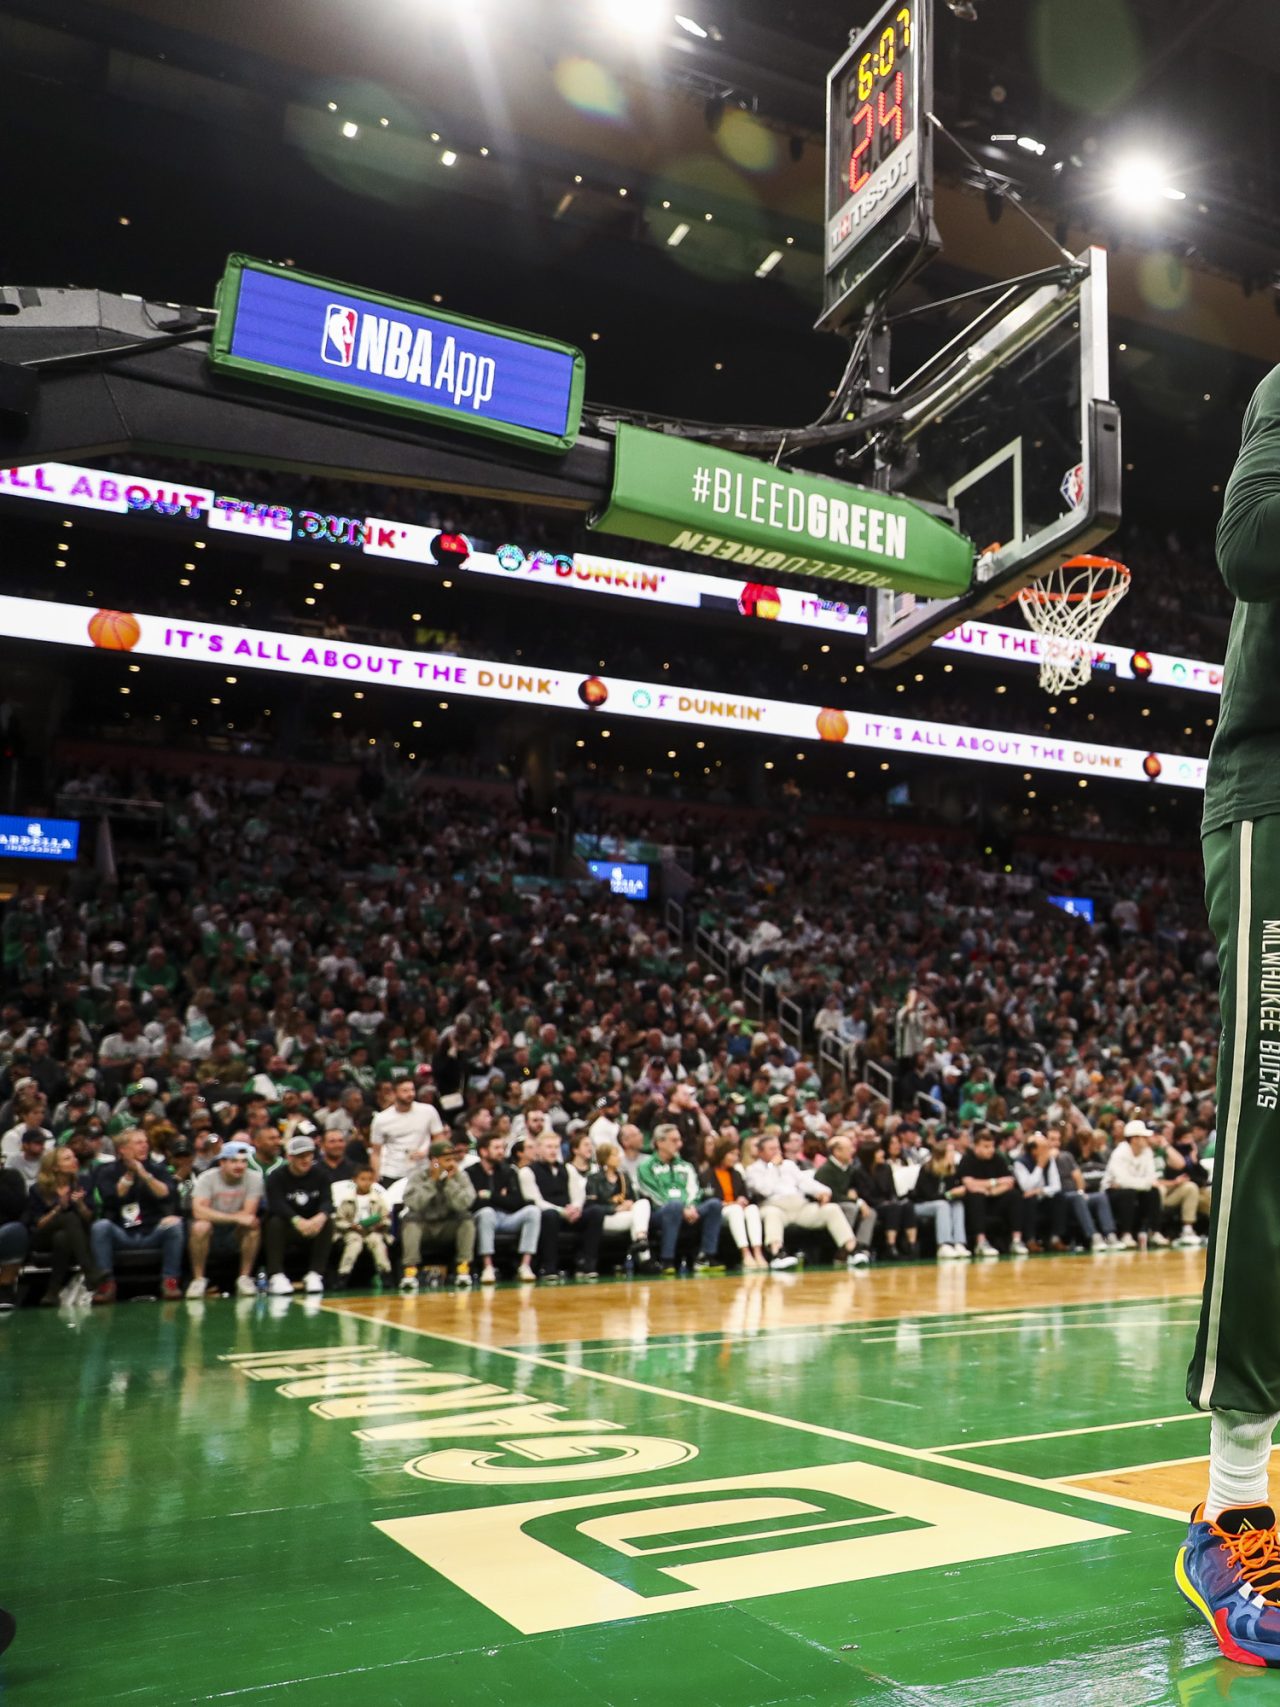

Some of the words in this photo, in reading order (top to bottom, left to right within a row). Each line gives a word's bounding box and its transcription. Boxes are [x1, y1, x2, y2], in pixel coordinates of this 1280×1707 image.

[858, 8, 910, 101] 6:07
[850, 71, 903, 192] 24
[851, 152, 911, 227] TISSOT
[357, 313, 433, 387] NBA
[434, 336, 496, 410] App
[0, 467, 54, 493] LL
[71, 475, 206, 519] ABOUT
[215, 496, 293, 531] THE
[691, 466, 907, 559] #BLEEDGREEN
[553, 554, 665, 593] DUNKIN'
[164, 628, 223, 652] IT'S
[233, 638, 290, 661] ALL
[301, 647, 402, 676] ABOUT
[413, 661, 467, 684] THE
[477, 670, 559, 695] DUNK'
[943, 625, 988, 646] OUT
[998, 633, 1040, 655] THE
[678, 696, 767, 721] DUNKIN'
[865, 723, 902, 741] IT'S
[911, 730, 947, 746] ALL
[956, 735, 1021, 755] ABOUT
[1030, 745, 1065, 762] THE
[216, 1344, 700, 1485] GARDEN
